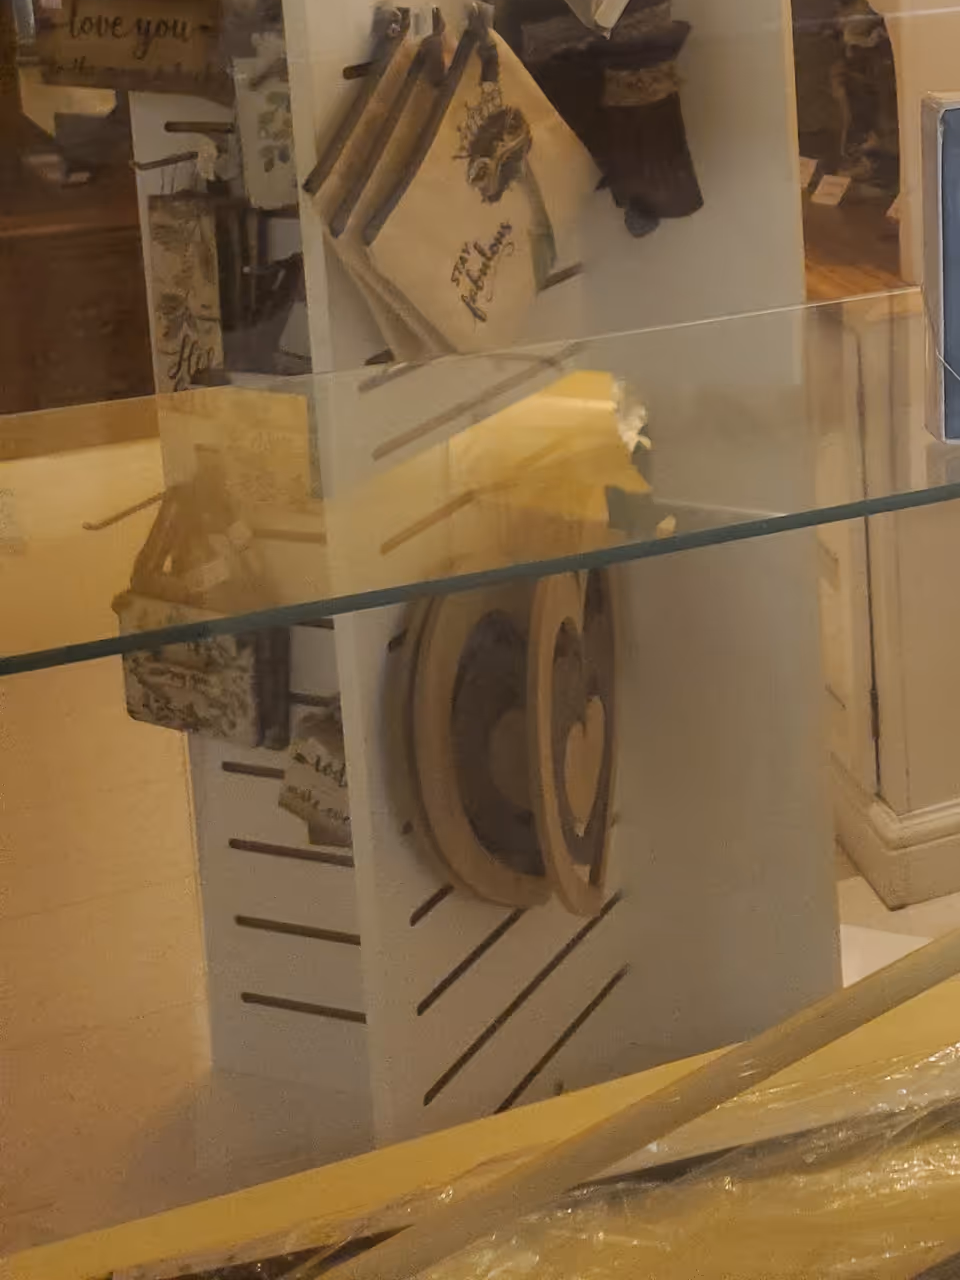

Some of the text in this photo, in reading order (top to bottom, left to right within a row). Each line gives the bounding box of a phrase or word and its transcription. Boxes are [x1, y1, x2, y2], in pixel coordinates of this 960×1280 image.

[132, 17, 192, 60] you
[450, 241, 471, 288] STAY
[460, 220, 515, 323] fabulous
